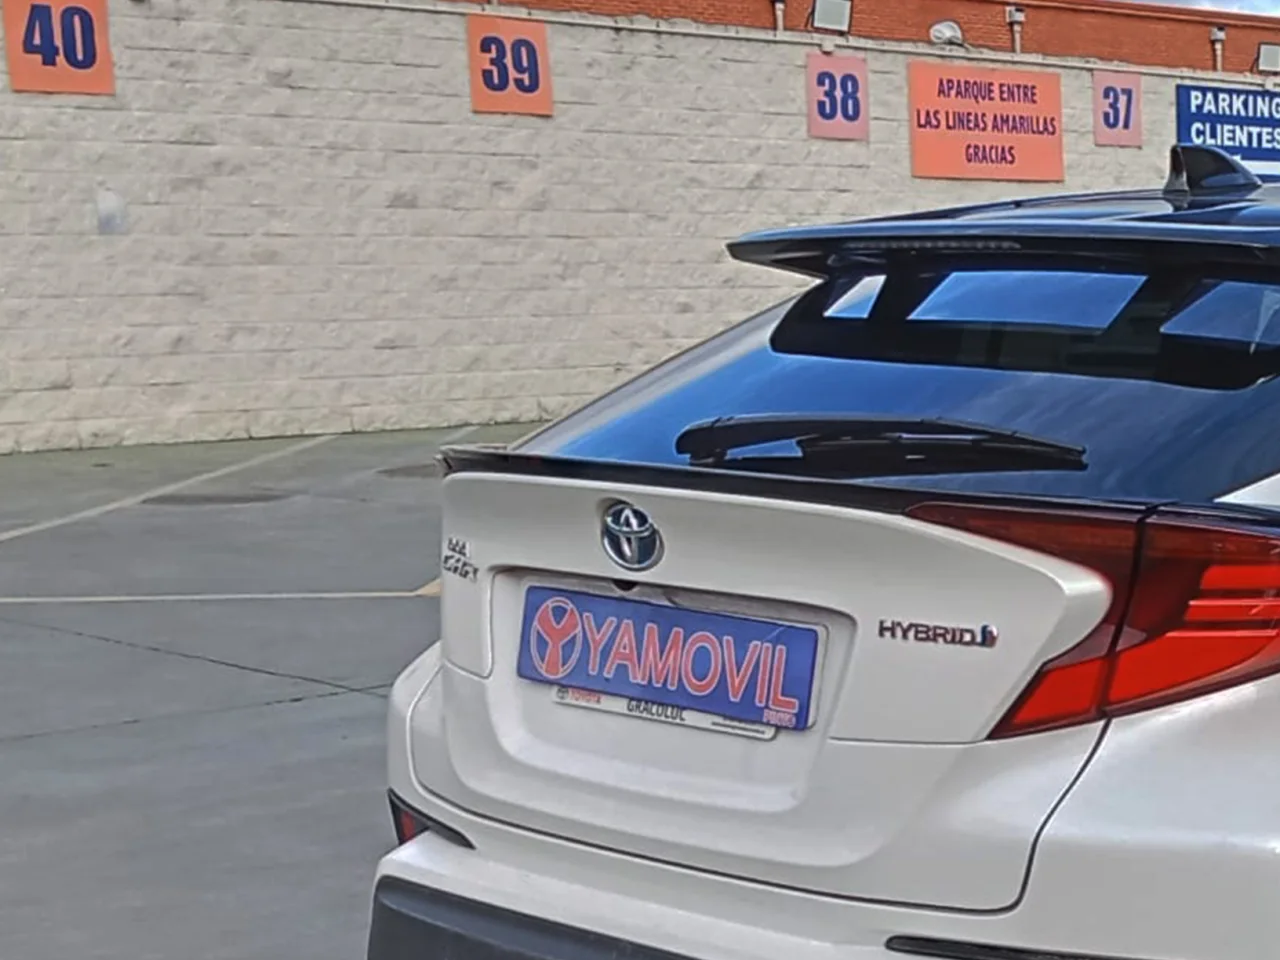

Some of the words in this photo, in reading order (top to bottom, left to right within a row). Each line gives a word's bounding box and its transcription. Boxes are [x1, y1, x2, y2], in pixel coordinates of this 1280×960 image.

[21, 3, 98, 70] 40
[479, 35, 541, 94] 39
[816, 71, 861, 122] 38
[937, 77, 995, 104] APARQUE
[999, 83, 1037, 104] ENTRE
[1102, 86, 1133, 130] 37
[916, 108, 941, 129] LAS
[946, 110, 987, 131] LINEAS
[992, 113, 1057, 135] AMARILLAS
[965, 143, 1016, 165] GRACIAS
[878, 619, 977, 646] HYBRID
[583, 612, 799, 712] YAMOVIL
